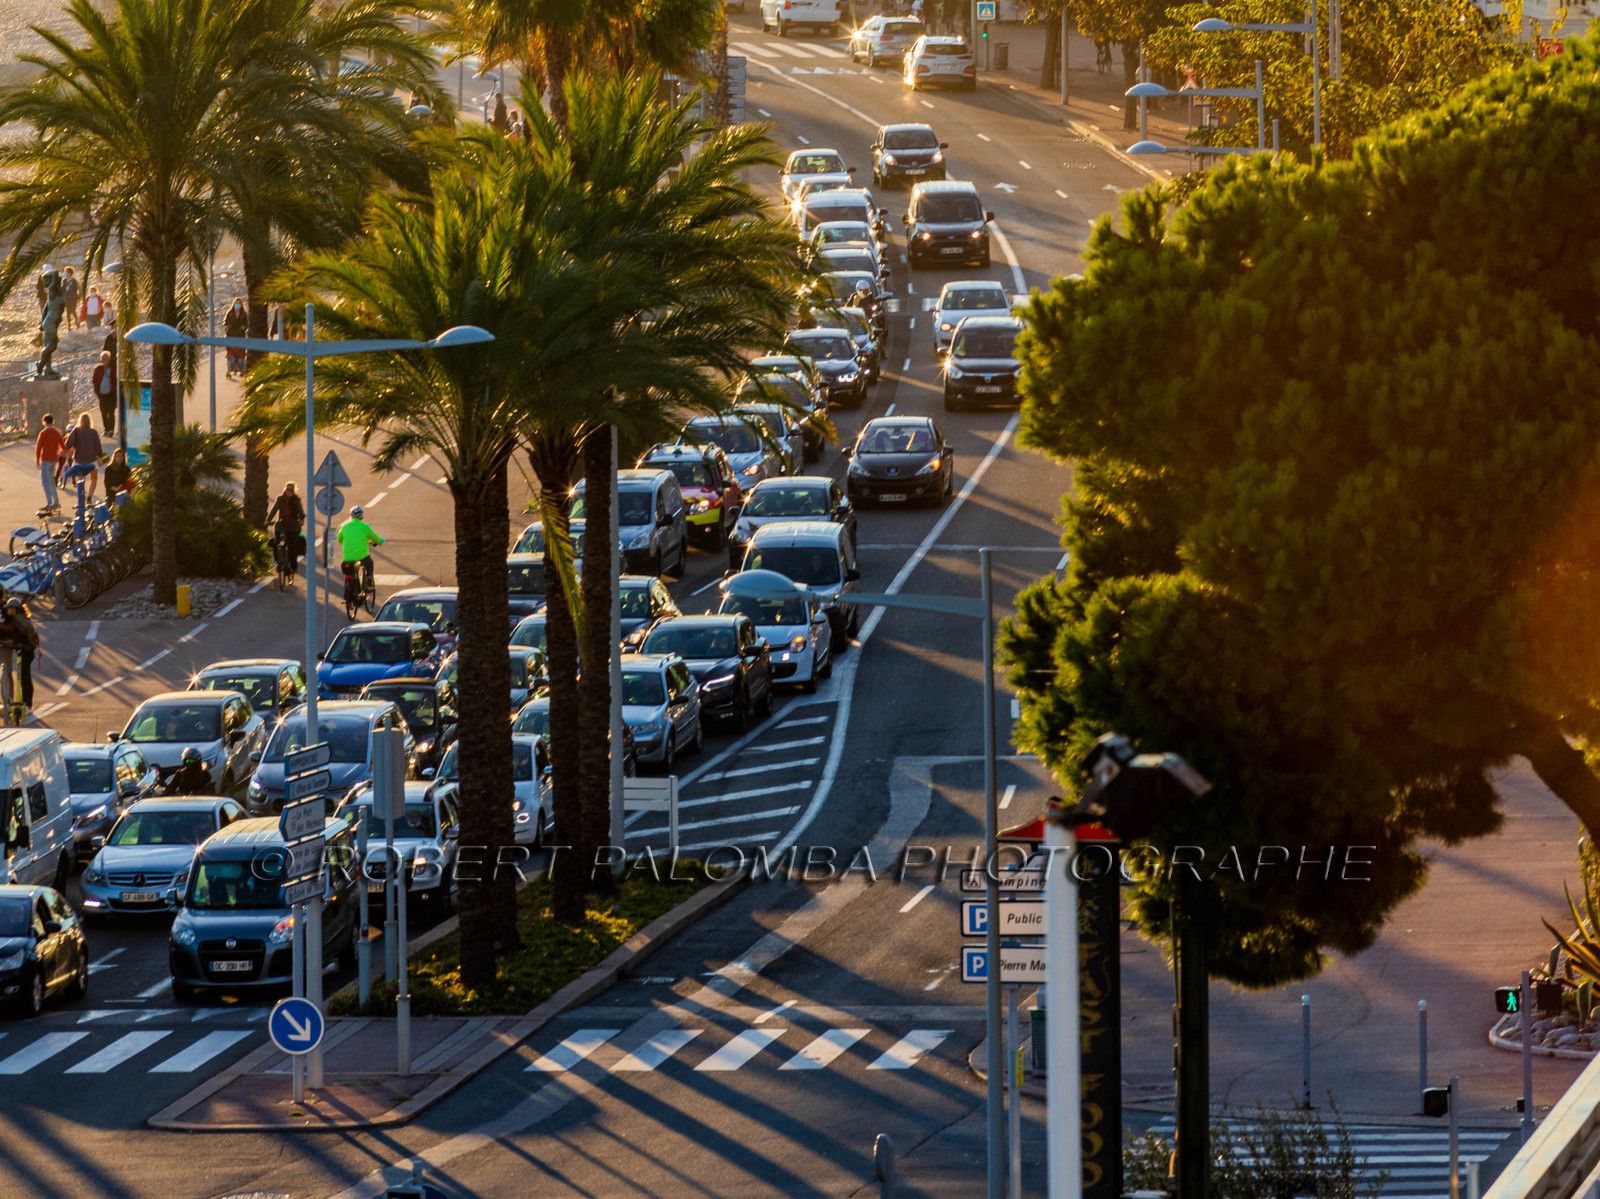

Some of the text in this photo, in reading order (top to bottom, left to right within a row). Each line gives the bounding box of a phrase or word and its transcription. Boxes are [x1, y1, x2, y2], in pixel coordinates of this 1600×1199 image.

[1007, 913, 1042, 924] Public
[999, 959, 1027, 971] Pierre
[1029, 959, 1046, 971] Ma
